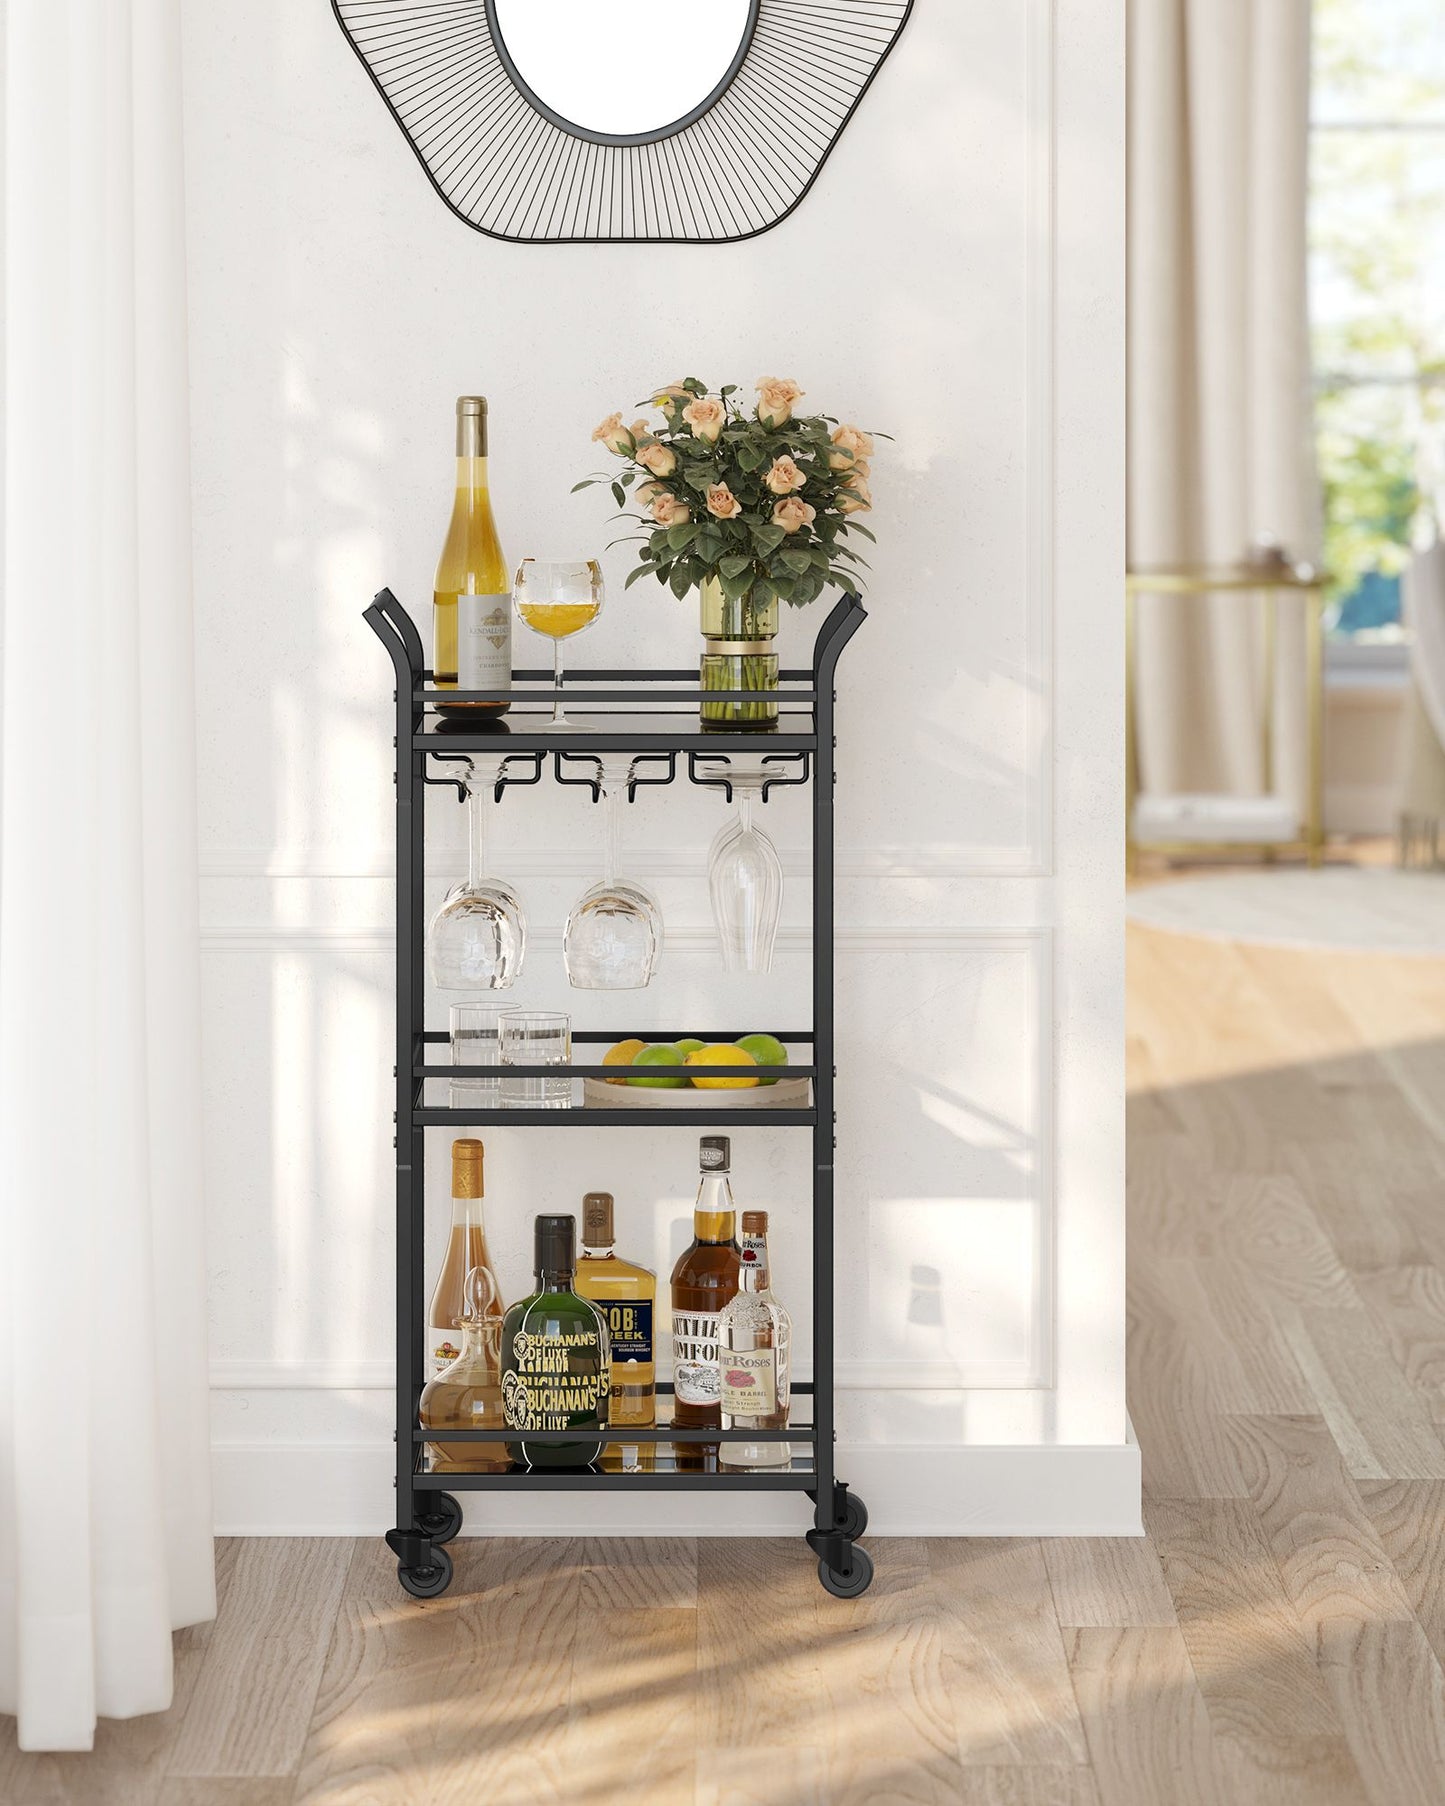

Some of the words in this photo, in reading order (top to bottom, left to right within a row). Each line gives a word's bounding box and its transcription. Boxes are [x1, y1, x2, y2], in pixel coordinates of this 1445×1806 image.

[602, 1307, 634, 1331] OB
[673, 1317, 719, 1338] UTHE
[527, 1332, 597, 1347] BUCHANAN'S
[733, 1356, 771, 1368] Roses
[527, 1385, 597, 1412] BUCHANAN'S
